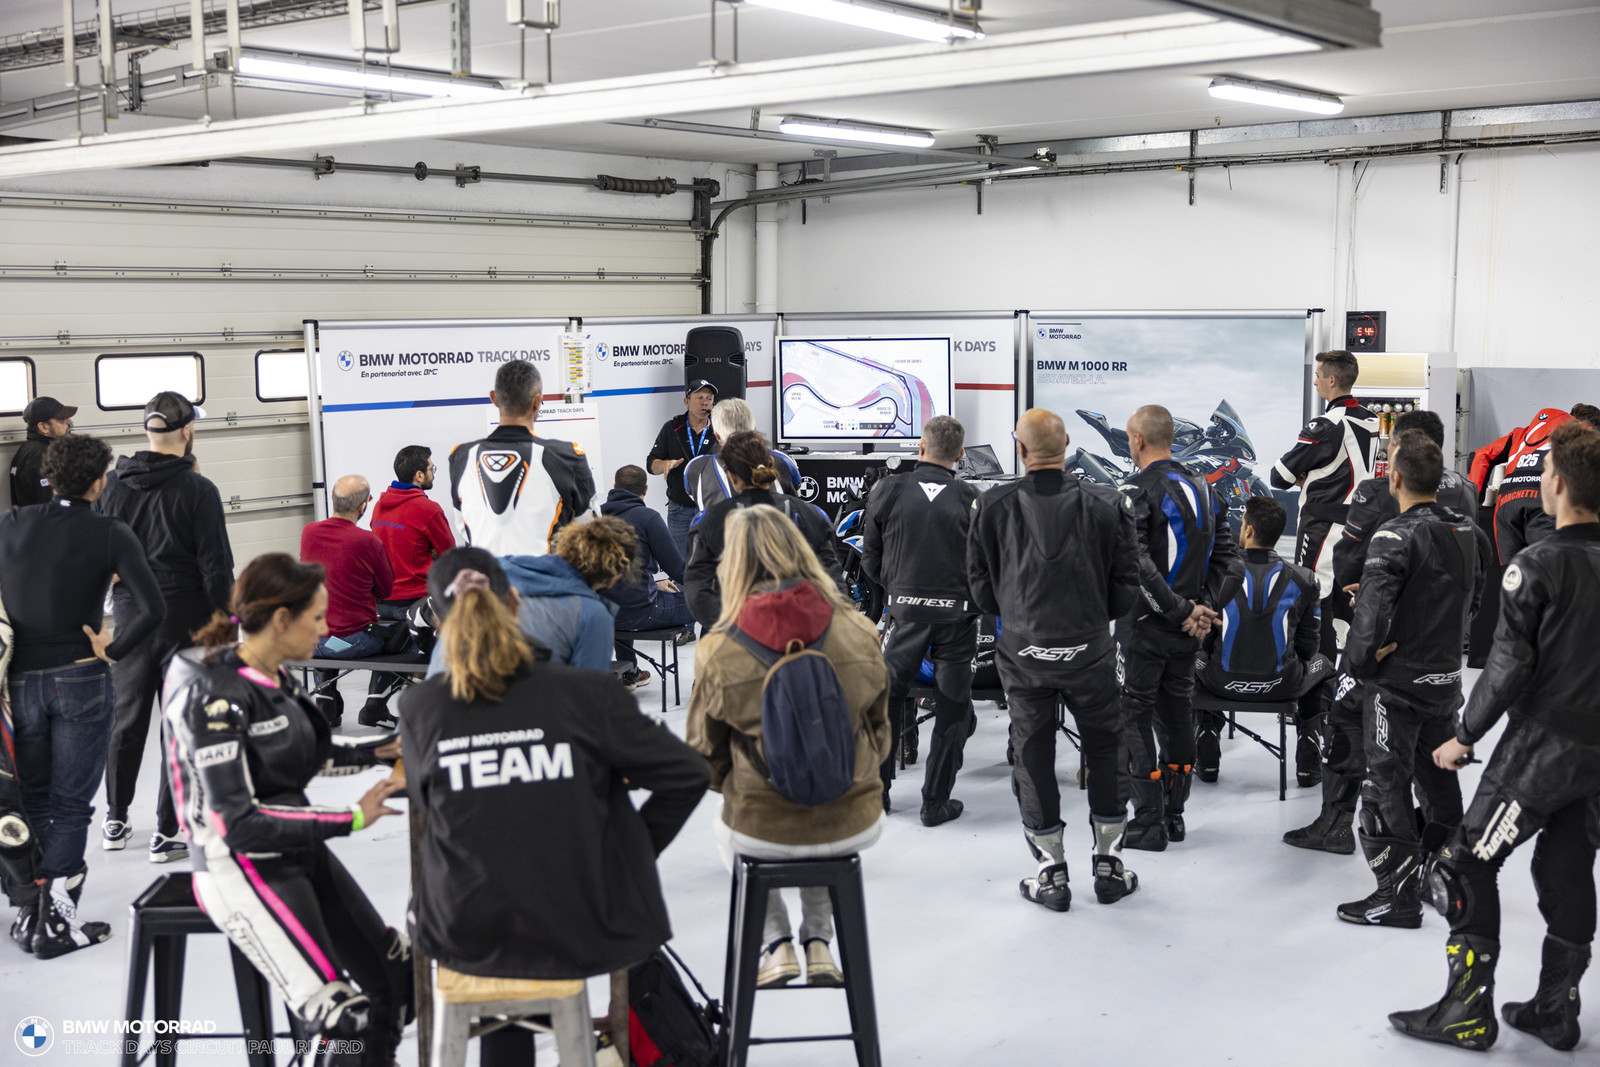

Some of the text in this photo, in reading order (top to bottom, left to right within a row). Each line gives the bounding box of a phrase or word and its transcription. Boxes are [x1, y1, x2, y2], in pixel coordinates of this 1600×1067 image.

[613, 341, 762, 357] BMW MOTORR AYS
[964, 341, 996, 352] DAYS
[359, 349, 550, 366] BMW MOTORRAD TRACK DAYS
[621, 359, 650, 368] partenariat
[1037, 361, 1127, 371] BMW M 1000 RR
[370, 370, 407, 379] partenariat
[896, 595, 956, 608] DAINESE
[1018, 643, 1088, 661] RST
[1224, 677, 1283, 694] RST
[1374, 693, 1390, 752] RST
[437, 728, 544, 753] BMW MOTORRAD
[438, 742, 574, 791] TEAM
